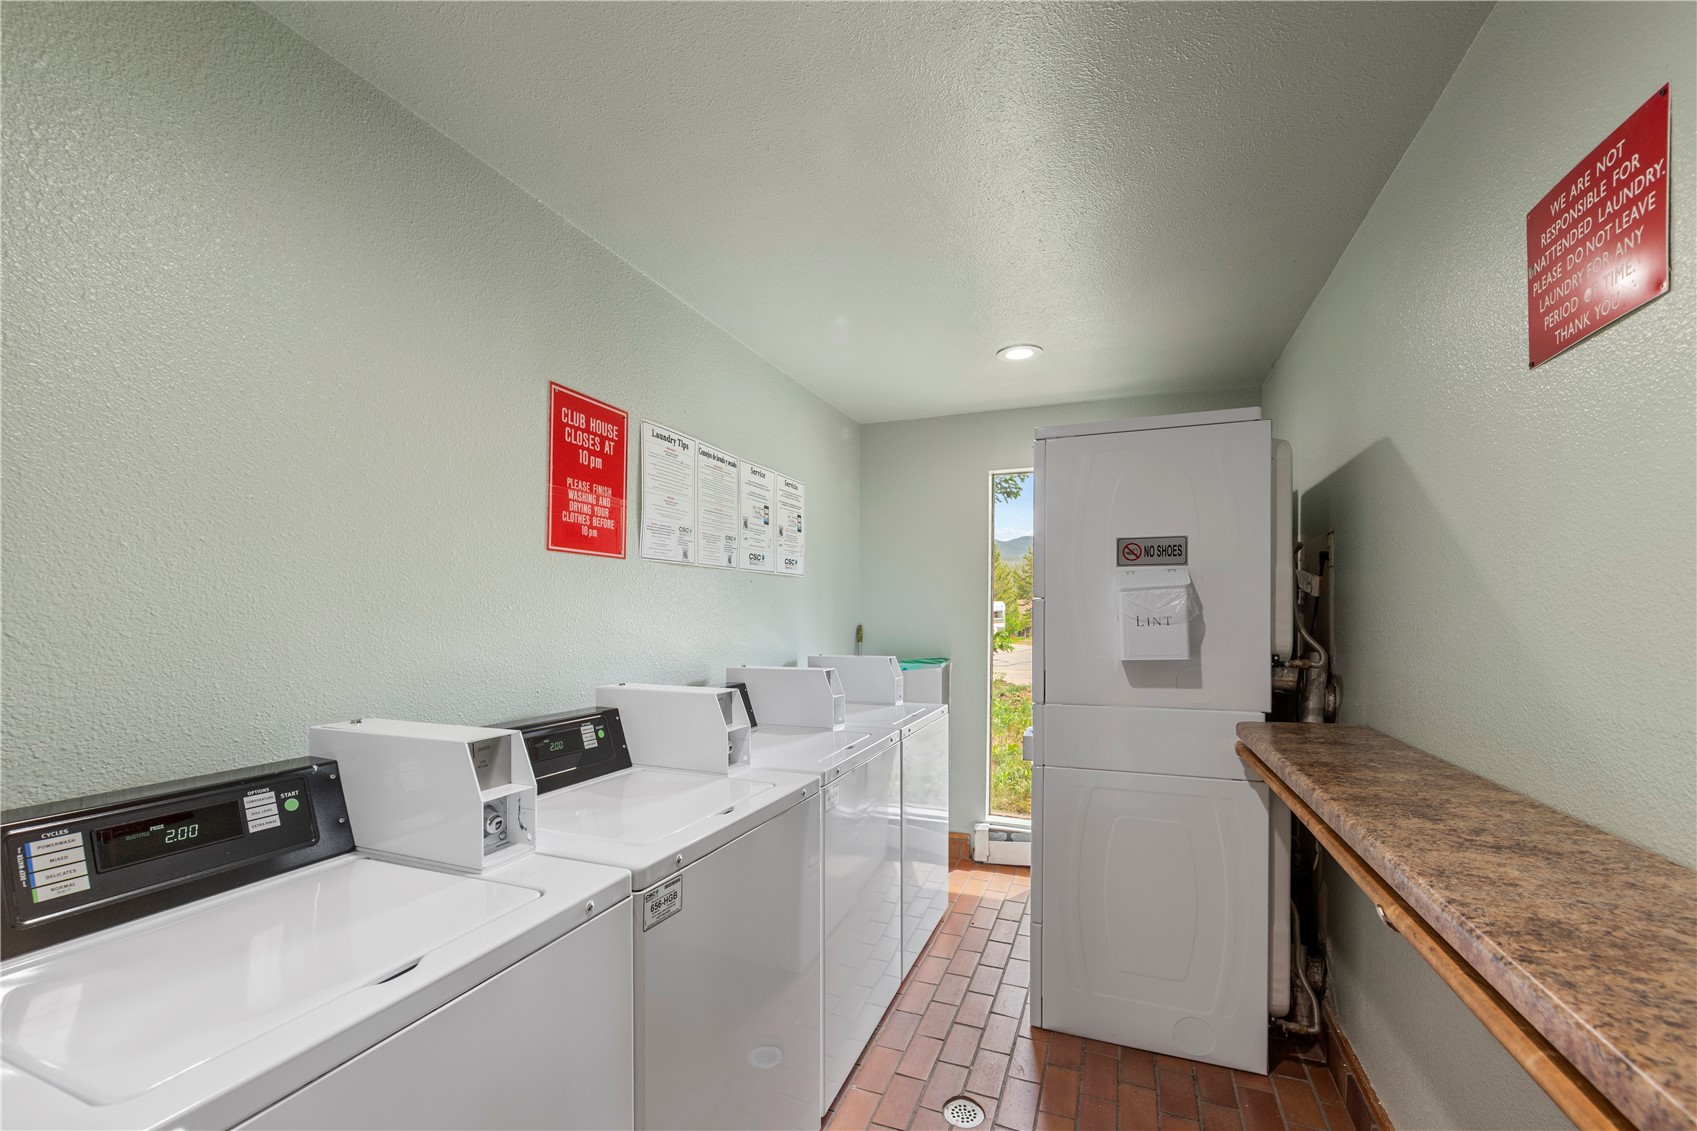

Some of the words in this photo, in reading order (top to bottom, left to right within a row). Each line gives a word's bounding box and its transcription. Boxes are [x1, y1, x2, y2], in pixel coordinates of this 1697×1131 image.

[1550, 199, 1566, 216] WE
[1569, 170, 1590, 202] ARE
[1596, 139, 1625, 177] NOT
[1598, 158, 1666, 223] LAUNDRY.
[1540, 184, 1607, 248] RESPONSIBLE
[1613, 153, 1640, 187] FOR
[1533, 268, 1563, 297] PLEASE
[1566, 247, 1583, 271] DO
[1586, 223, 1613, 257] NOT
[1615, 191, 1656, 234] LEAVE
[1539, 268, 1583, 313] LAUNDRY
[1586, 251, 1609, 283] FOR
[1615, 225, 1644, 257] ANY
[1544, 298, 1578, 331] PERIOD
[1603, 259, 1636, 290] TIME.
[1554, 315, 1590, 345] THANK
[562, 407, 586, 429] CLUB
[590, 417, 618, 440] HOUSE
[565, 427, 600, 451] CLOSES
[604, 440, 614, 455] AT
[652, 429, 676, 446] Laundry
[678, 438, 689, 450] Tips
[579, 449, 588, 465] 10
[590, 455, 602, 470] pm
[751, 467, 765, 478] Service
[567, 478, 590, 492] PLEASE
[593, 484, 612, 497] FINISH
[568, 489, 596, 504] WASHING
[599, 495, 610, 508] AND
[569, 501, 591, 514] DRYING
[594, 506, 608, 518] YOUR
[562, 511, 590, 525] CLOTHES
[593, 517, 614, 529] BEFORE
[582, 526, 588, 536] 10
[589, 529, 597, 537] pm
[1144, 546, 1155, 557] NO
[1157, 544, 1182, 557] SHOES
[1136, 616, 1172, 627] LINT
[247, 787, 269, 795] OPTIONS
[280, 790, 299, 798] START
[41, 829, 69, 838] CYCLES
[165, 824, 198, 843] 2.00
[37, 838, 76, 850] POWERWASH
[46, 869, 76, 879] DELICATES
[51, 883, 76, 891] NORMAL
